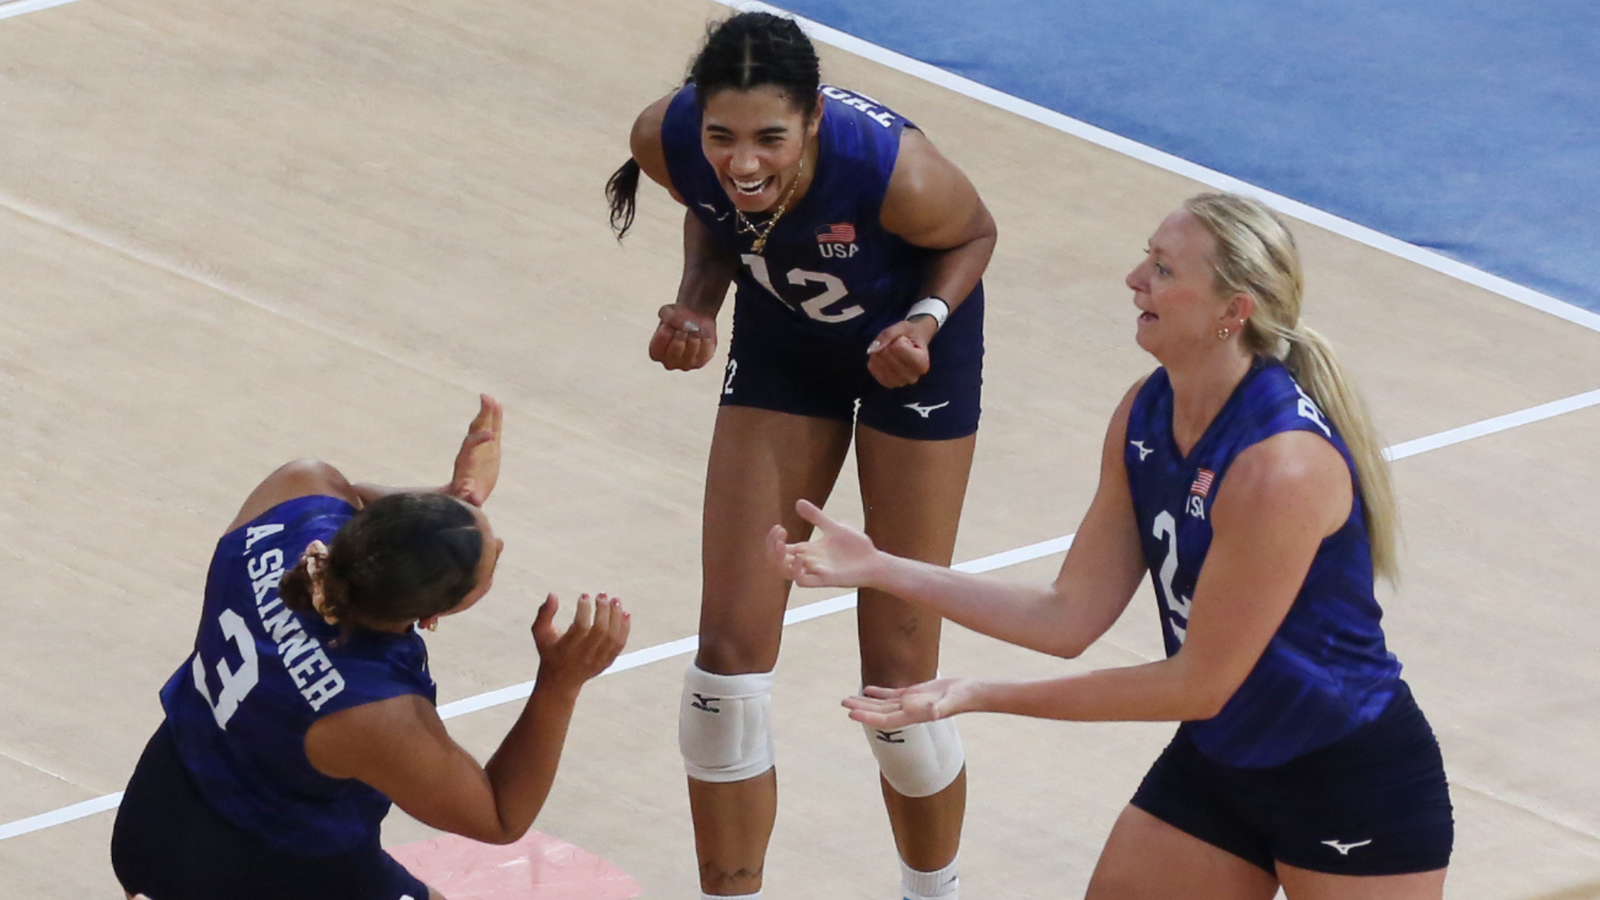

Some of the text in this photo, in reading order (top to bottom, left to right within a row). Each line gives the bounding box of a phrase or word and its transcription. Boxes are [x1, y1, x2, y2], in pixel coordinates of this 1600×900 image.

[818, 243, 859, 258] USA
[740, 254, 865, 323] 12
[192, 608, 258, 731] 3
